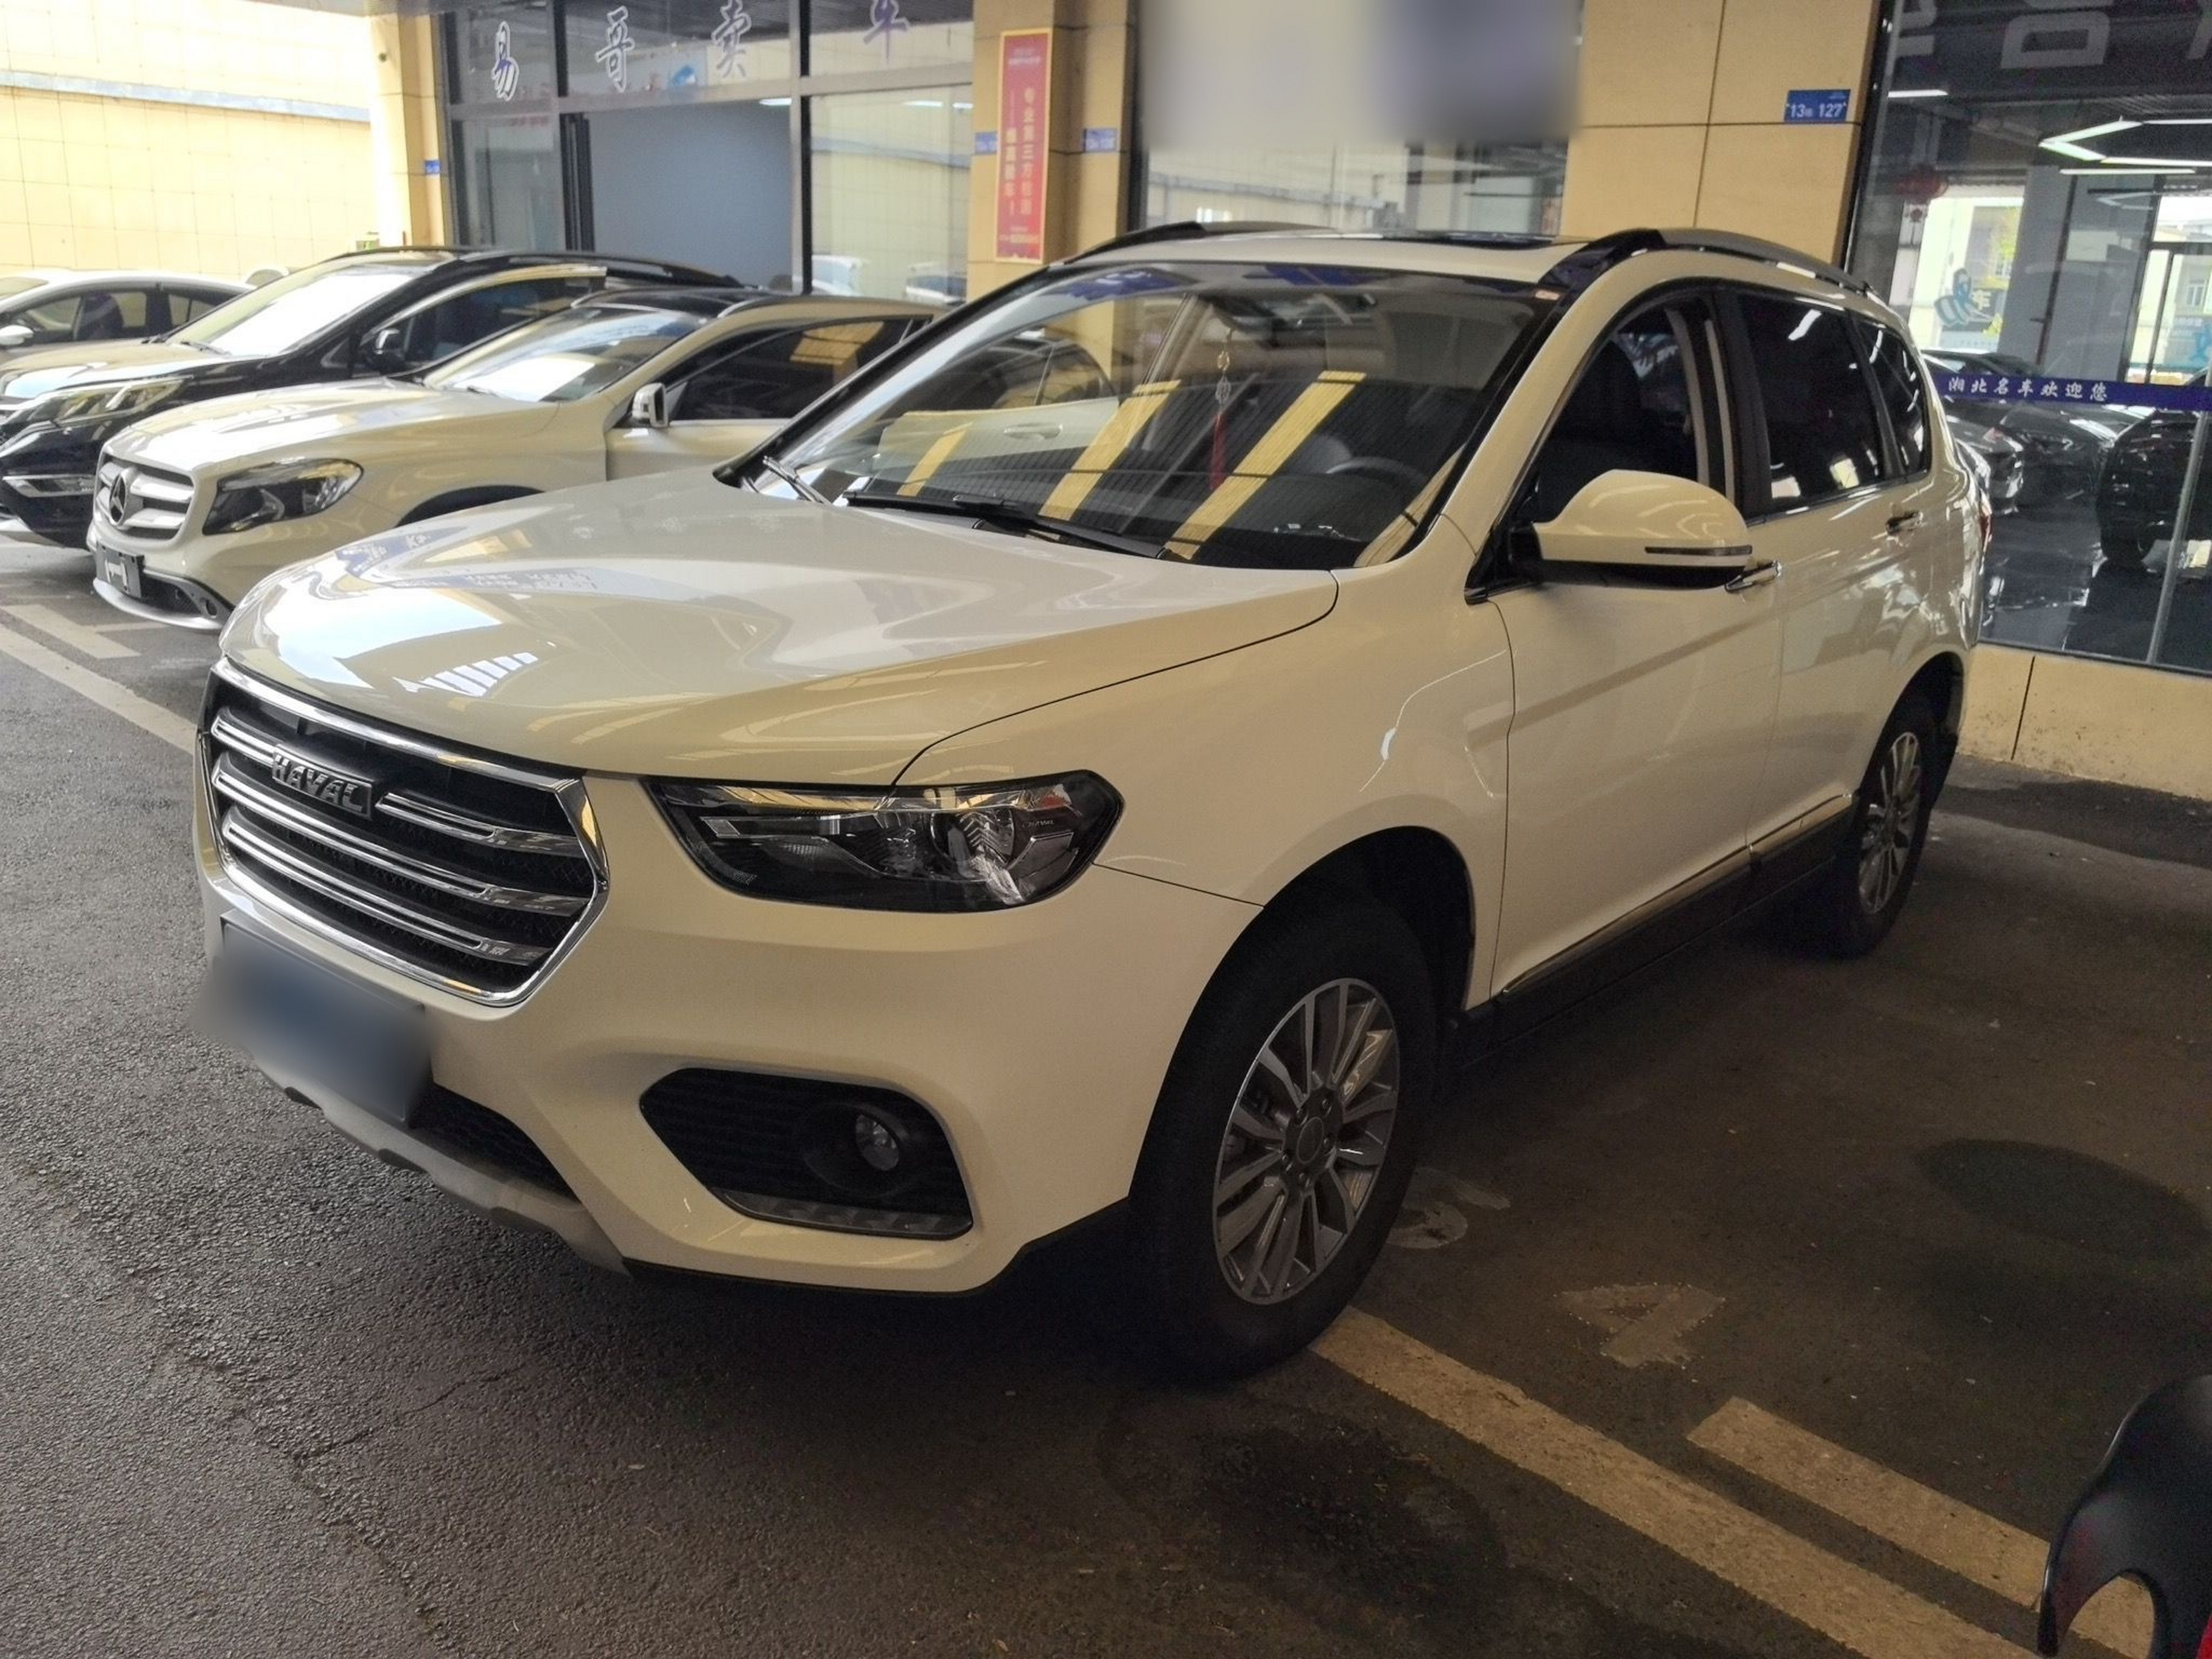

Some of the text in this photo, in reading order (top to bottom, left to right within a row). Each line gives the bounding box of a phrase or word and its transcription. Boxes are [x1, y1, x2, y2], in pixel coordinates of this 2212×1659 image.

[1819, 103, 1843, 118] 127
[1948, 377, 2107, 401] 湘北名车欢迎您
[272, 754, 363, 812] HAVAL
